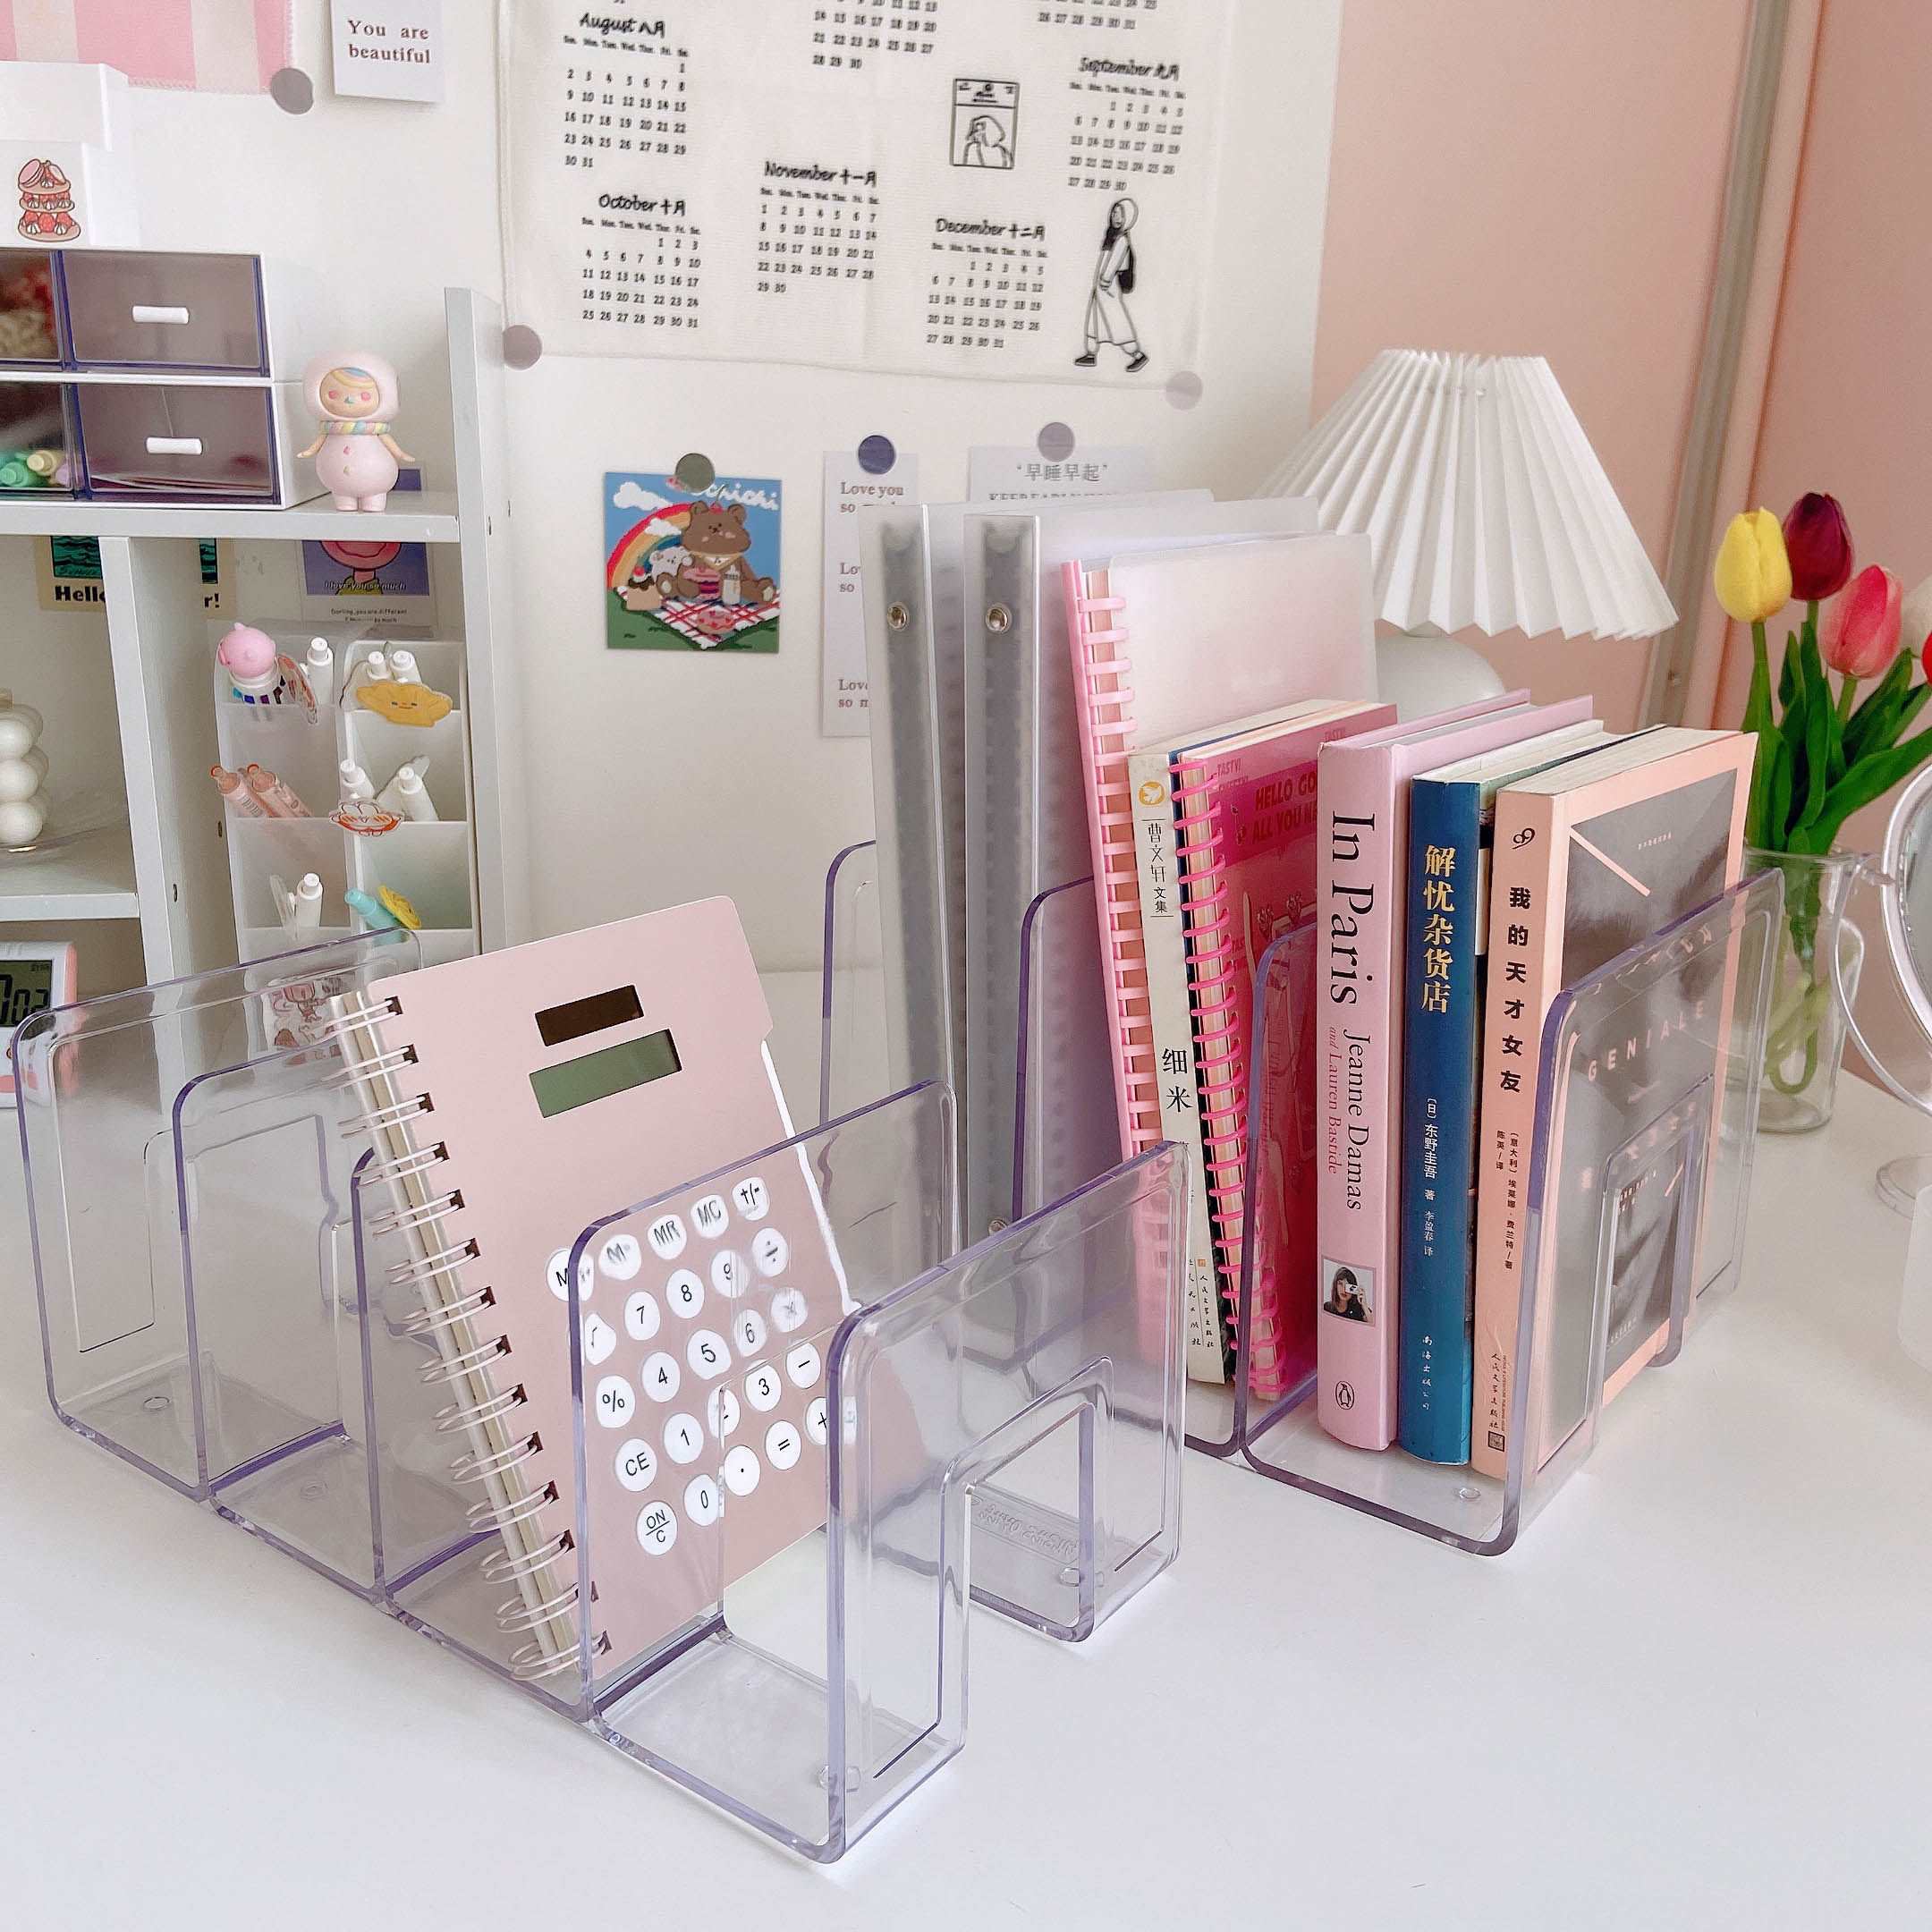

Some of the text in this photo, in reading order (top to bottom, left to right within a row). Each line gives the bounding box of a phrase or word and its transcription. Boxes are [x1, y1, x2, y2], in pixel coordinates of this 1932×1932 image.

[347, 20, 430, 40] You are
[580, 13, 666, 38] August 八月
[348, 44, 430, 64] beautiful
[1079, 57, 1153, 78] September
[567, 89, 686, 113] 9 10 11 12 13 14 15
[564, 112, 686, 134] 16 17 18 19 20 21 22
[564, 133, 686, 156] 23 24 25 26 27 28 29
[564, 155, 594, 168] 30 31
[765, 161, 877, 188] November 十一月
[598, 194, 686, 216] October 十月
[936, 218, 1046, 242] December 十二月
[658, 237, 699, 250] 1 2 3
[586, 249, 701, 268] 4 5 6 7 8 9 10
[582, 268, 699, 287] 11 12 13 14 15 16 17
[582, 289, 699, 308] 18 19 20 21 22 23 24
[582, 309, 699, 328] 25 26 27 28 29 30 31
[840, 482, 904, 498] Love you
[840, 503, 856, 513] so
[840, 583, 855, 593] so
[838, 699, 853, 708] so
[1255, 778, 1293, 811] HELLO
[1299, 771, 1318, 796] GO
[1252, 815, 1273, 844] ALL
[1276, 805, 1302, 836] YOU
[1420, 844, 1456, 1013] 解忧杂货店
[1500, 886, 1531, 1093] 我的天才女友
[1330, 810, 1376, 1211] In Paris Jeanne Damas
[1588, 1001, 1705, 1081] GENIALE
[1162, 1047, 1193, 1113] 细米
[1327, 1026, 1343, 1175] and Lauren Bastide
[653, 1220, 680, 1245] MR
[697, 1199, 722, 1227] MC
[636, 1306, 646, 1325] 7
[681, 1284, 692, 1303] 8
[723, 1263, 733, 1282] 9
[602, 1324, 756, 1412] % 4 5 6
[625, 1452, 651, 1478] CE
[681, 1428, 691, 1446] 1
[758, 1377, 771, 1396] 3
[700, 1490, 709, 1510] 0
[646, 1509, 666, 1530] ON
[656, 1530, 666, 1545] C
